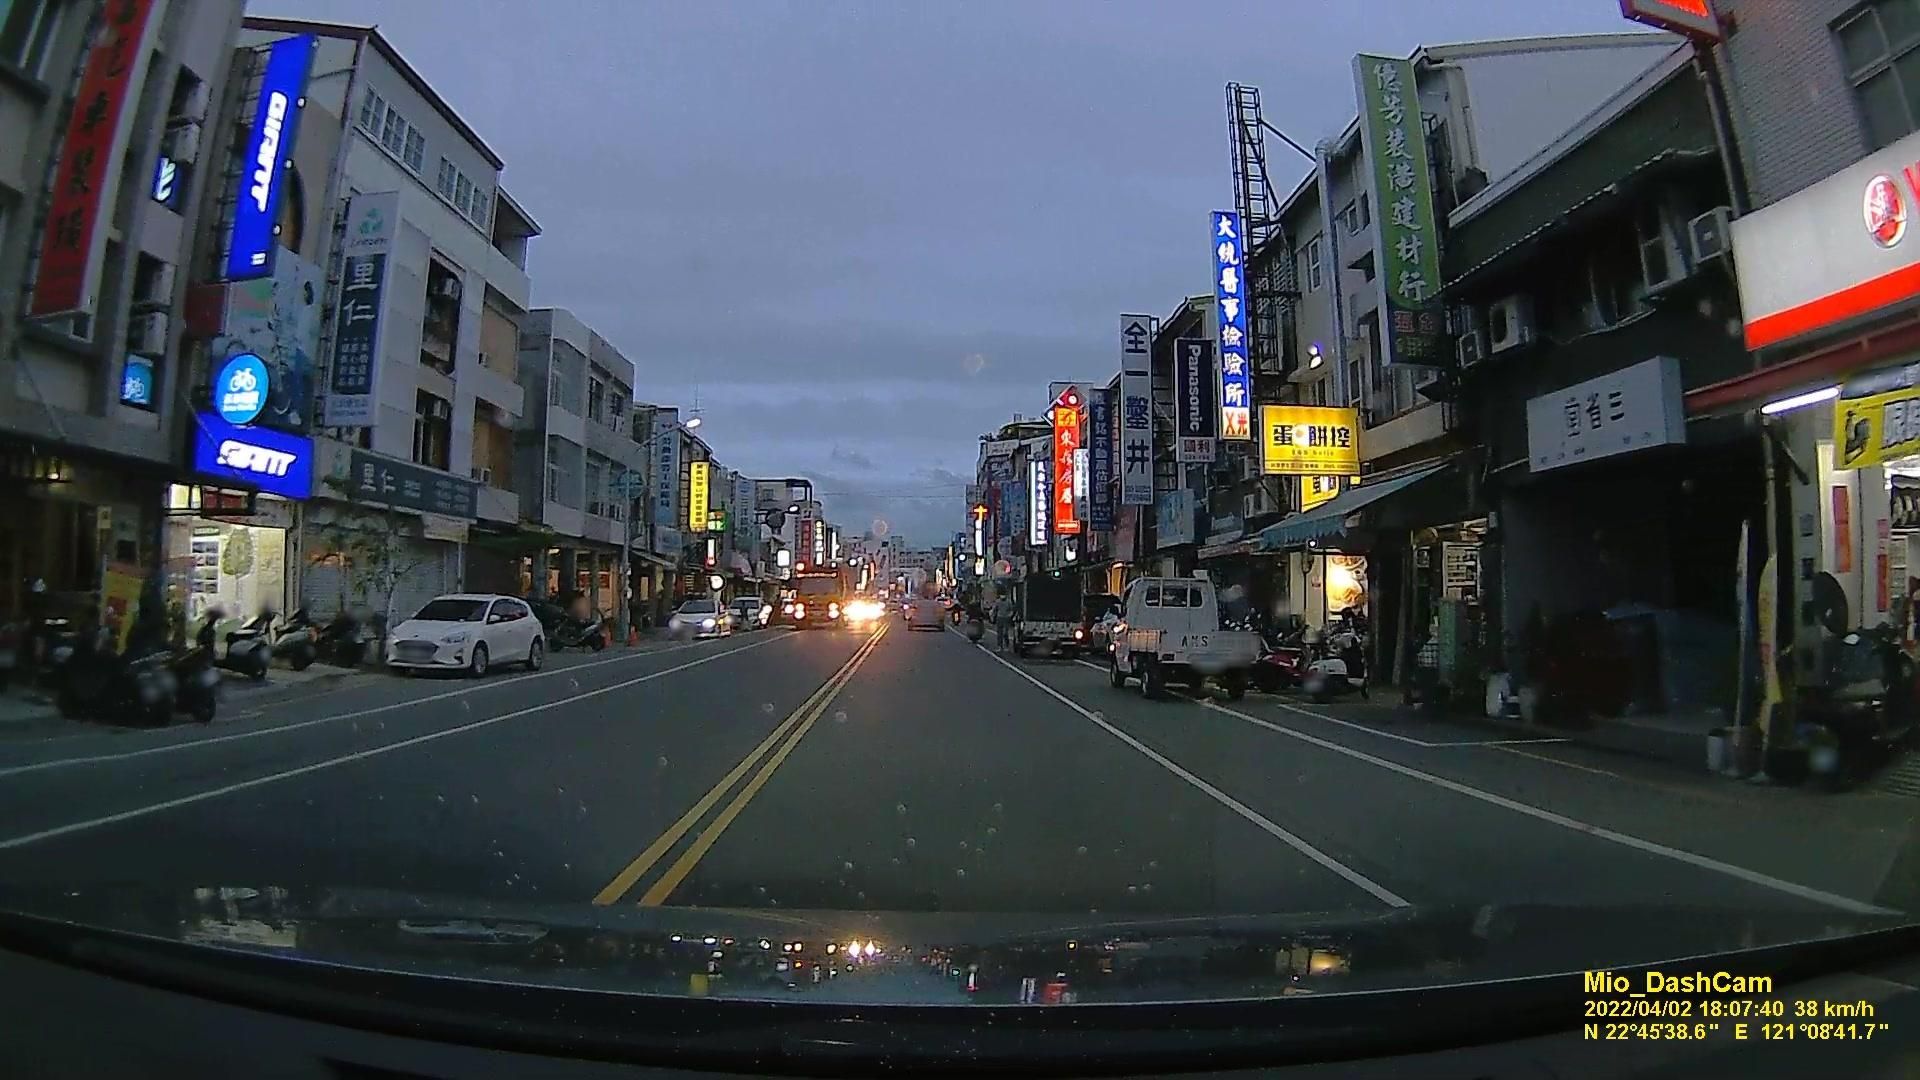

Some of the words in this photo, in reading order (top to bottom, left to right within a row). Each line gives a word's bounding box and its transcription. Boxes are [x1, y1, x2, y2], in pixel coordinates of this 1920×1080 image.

[343, 262, 378, 327] 里仁
[1187, 344, 1202, 433] Panasonic
[360, 463, 397, 494] 里仁
